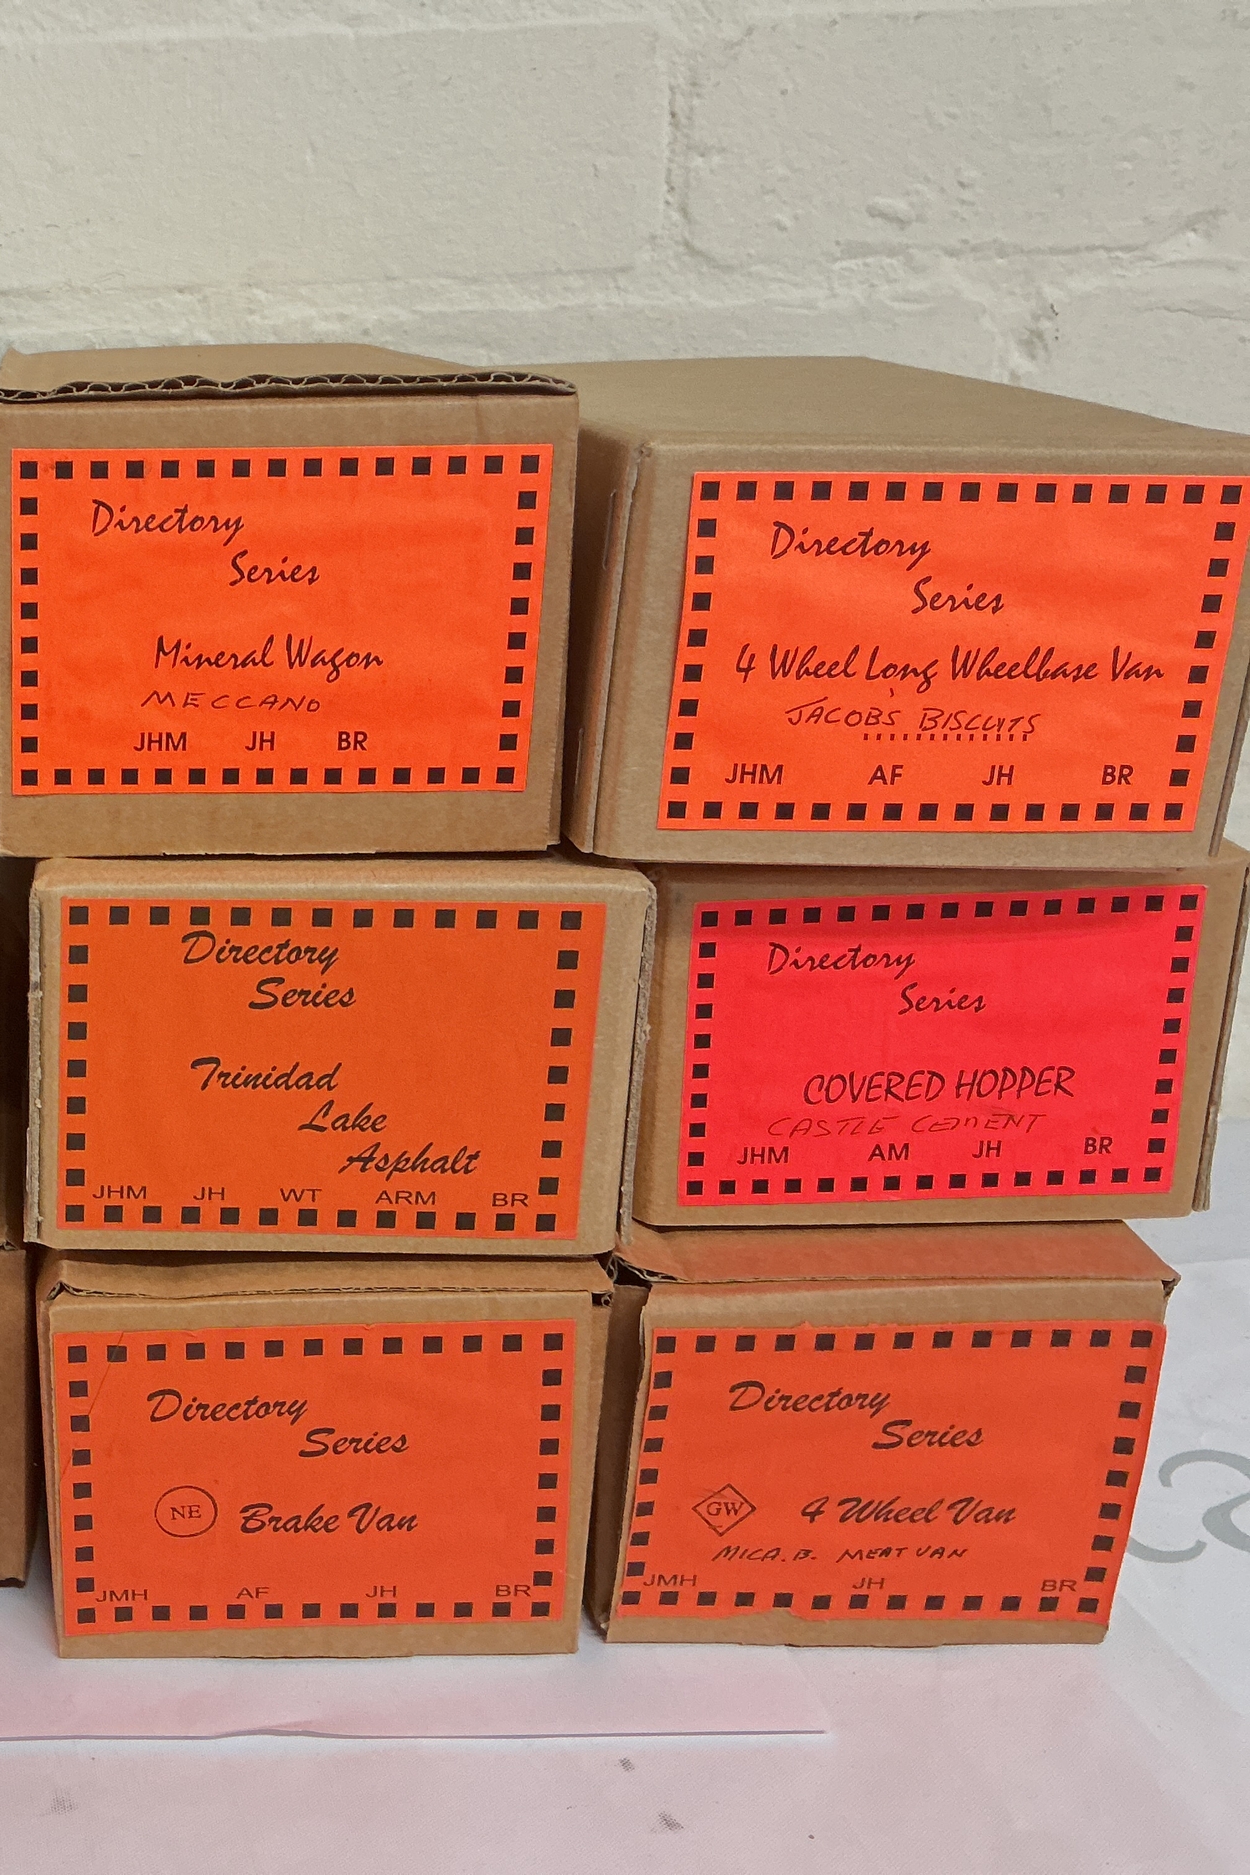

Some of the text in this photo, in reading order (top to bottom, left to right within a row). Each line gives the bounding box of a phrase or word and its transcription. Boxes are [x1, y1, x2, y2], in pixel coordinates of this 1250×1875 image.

[92, 499, 244, 544] Directory
[770, 521, 931, 570] Directory
[229, 550, 319, 587] Series
[911, 576, 1004, 614] Series
[154, 634, 384, 682] Mineral Wagon
[735, 643, 1164, 693] 4 Wheel Long Wheelbase Van
[141, 691, 320, 713] MECCANO
[919, 707, 1042, 734] BISCUITS
[133, 731, 368, 752] JHM JH BR
[725, 763, 1134, 786] JHM AF JH BR
[181, 930, 341, 974] Directory
[767, 942, 915, 979] Directory
[248, 977, 357, 1010] Series
[898, 982, 986, 1016] Series
[190, 1056, 341, 1093] Trinidad
[803, 1065, 1076, 1105] COVERED HOPPER
[297, 1100, 388, 1134] Lake
[338, 1140, 480, 1179] Asphalt
[736, 1136, 1113, 1166] JHM AM JH BR
[92, 1185, 528, 1207] JHM JH WT ARM BR
[146, 1388, 308, 1424] Directory
[727, 1381, 890, 1418] Directory
[298, 1427, 409, 1459] Series
[871, 1419, 983, 1451] Series
[170, 1505, 202, 1521] NE
[238, 1502, 418, 1535] Brake Van
[705, 1500, 744, 1517] GW
[800, 1496, 1017, 1525] 4 Wheel Van
[837, 1547, 906, 1562] MEAT
[915, 1547, 968, 1560] VAN
[95, 1584, 531, 1603] JMH AF JH BR
[643, 1573, 1076, 1592] JMH JH BR
